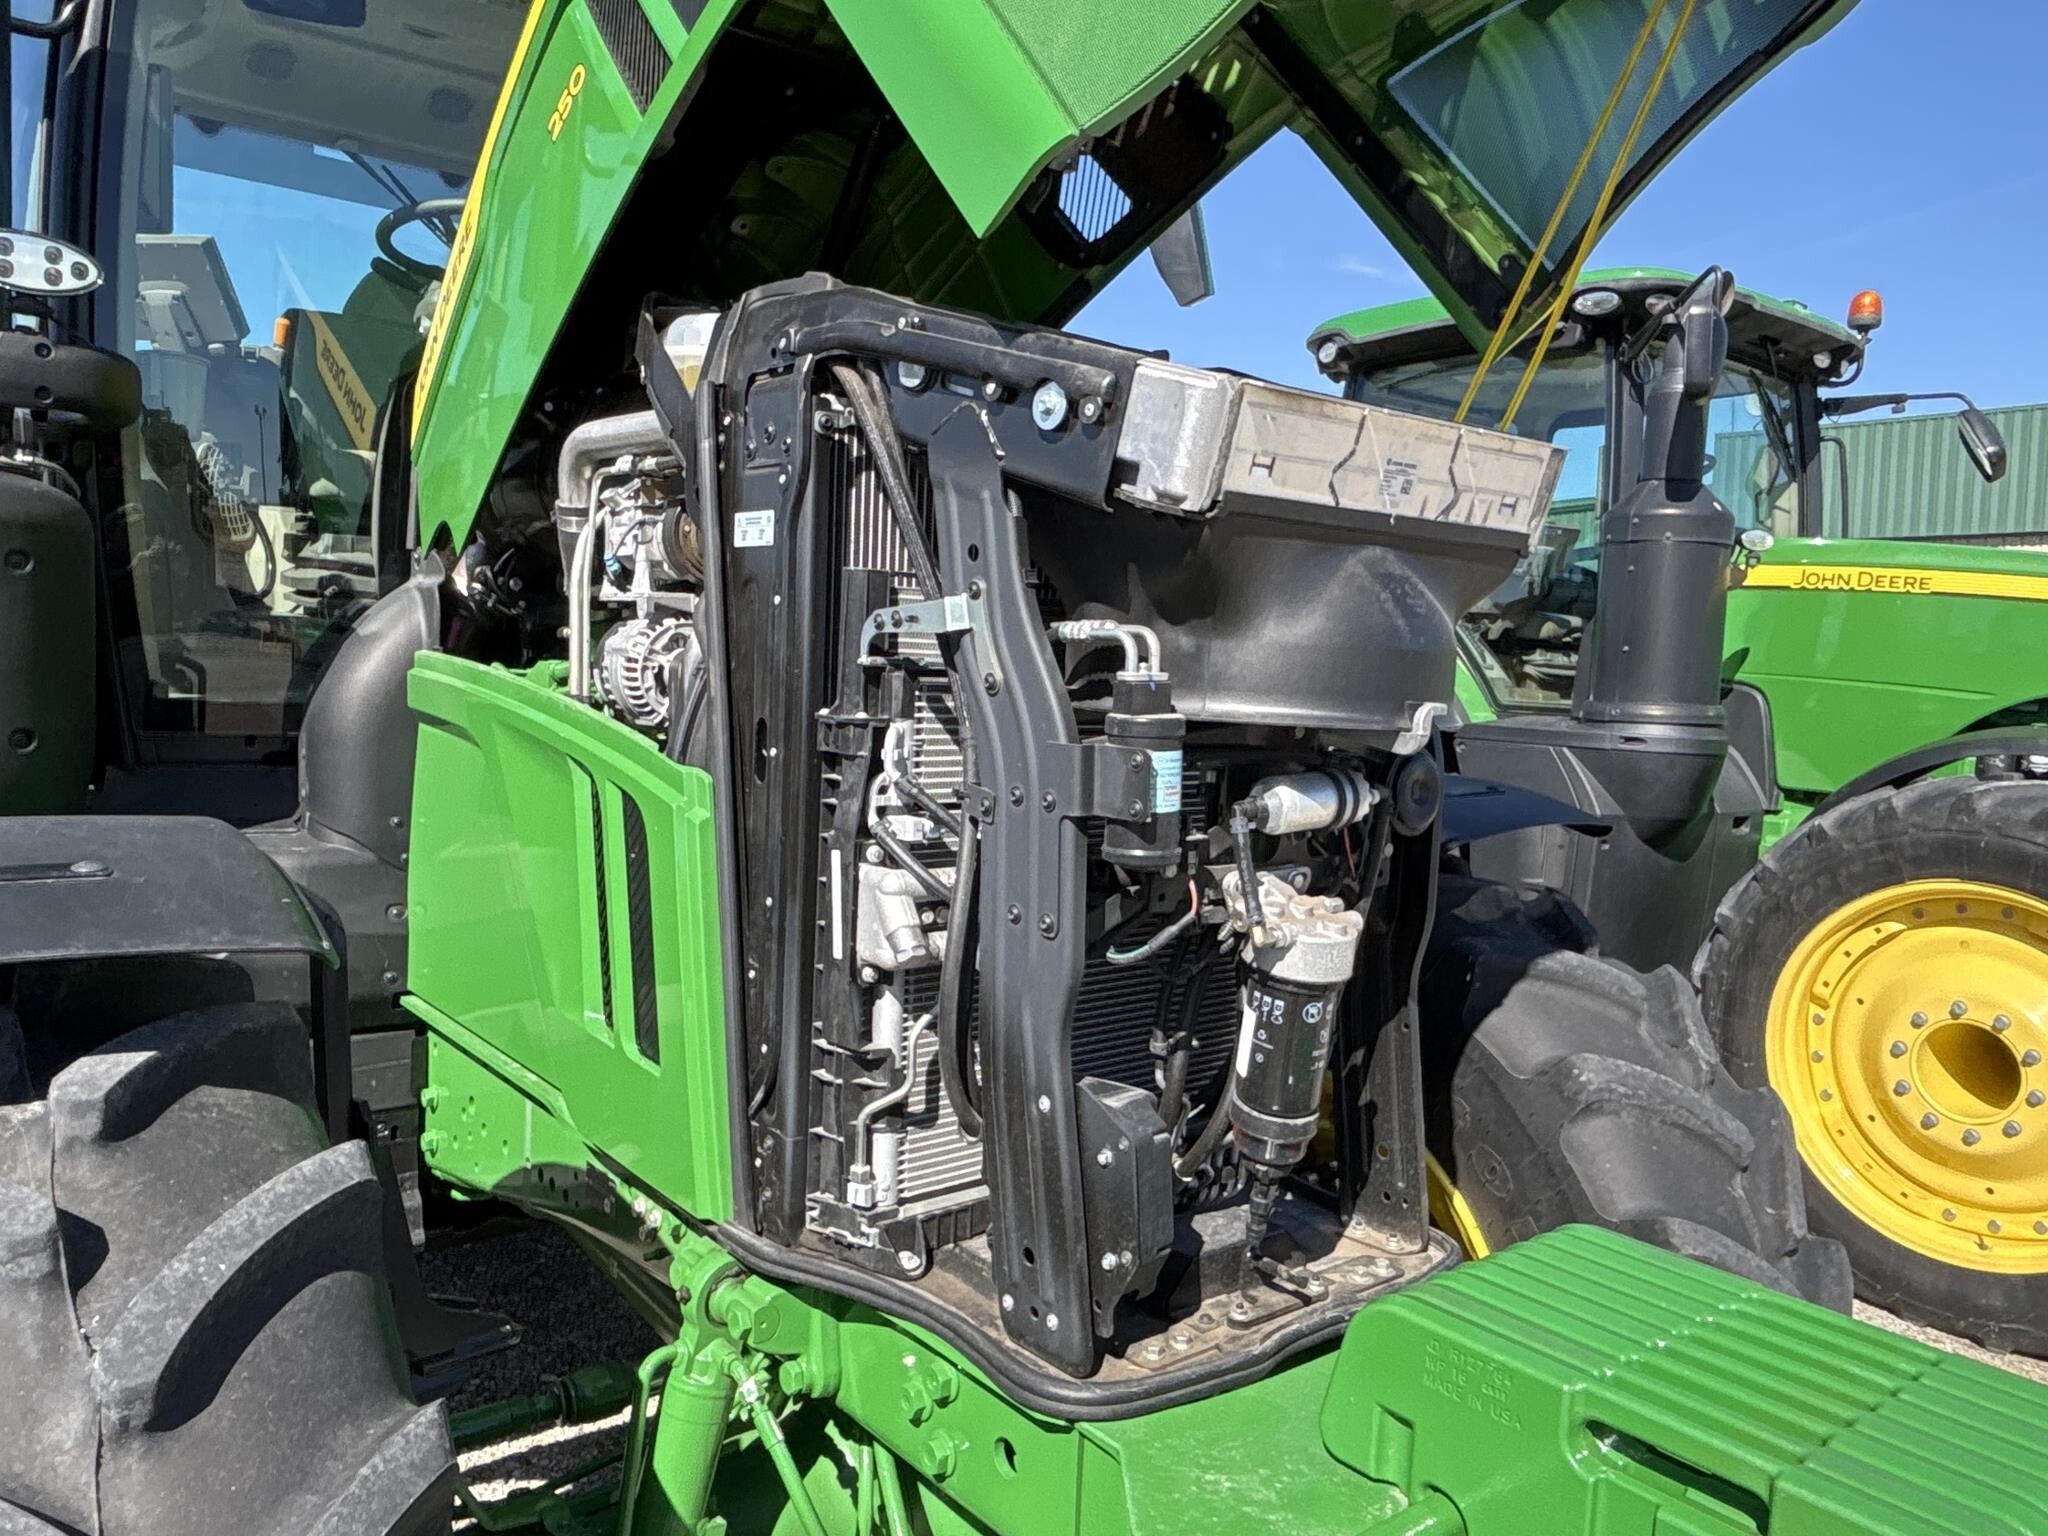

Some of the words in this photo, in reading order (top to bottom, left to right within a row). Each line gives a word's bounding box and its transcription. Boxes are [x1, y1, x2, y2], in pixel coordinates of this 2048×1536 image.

[547, 63, 586, 142] 250
[1794, 569, 1852, 586] JOHN
[1857, 571, 1933, 591] DEERE
[1422, 1372, 1462, 1402] MADE
[1467, 1393, 1483, 1412] IN
[1490, 1402, 1521, 1432] USA
